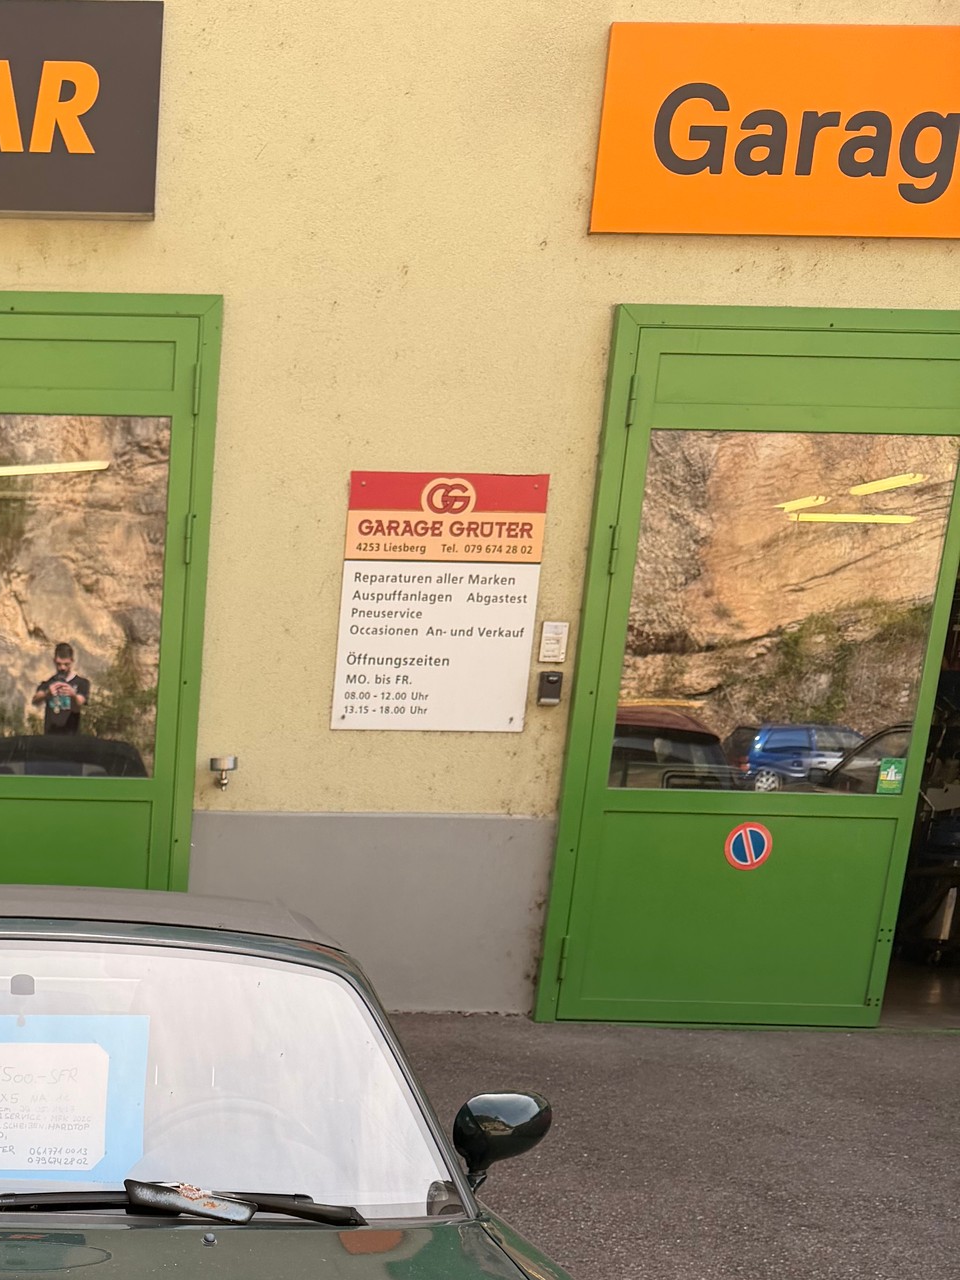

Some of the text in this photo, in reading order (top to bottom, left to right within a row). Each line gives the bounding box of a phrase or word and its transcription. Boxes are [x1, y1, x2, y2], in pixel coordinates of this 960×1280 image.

[358, 519, 443, 537] GARAGE
[356, 542, 532, 554] 4253 Liesberg Tel. 079 674 28 02
[354, 572, 516, 585] Reparaturen aller Marken
[352, 590, 528, 605] Auspuffanlagen Abgastest
[351, 608, 422, 619] Pneuservice
[350, 625, 525, 638] Occasionen An- und Verkauf
[346, 652, 450, 668] Öffnungszeiten
[346, 674, 412, 684] MO. bis FR.
[344, 691, 370, 700] 08.00
[381, 692, 406, 700] 12.00
[411, 692, 428, 700] Uhr
[380, 706, 405, 714] 18.00
[410, 706, 427, 714] Uhr
[48, 1123, 90, 1131] HARDTOP
